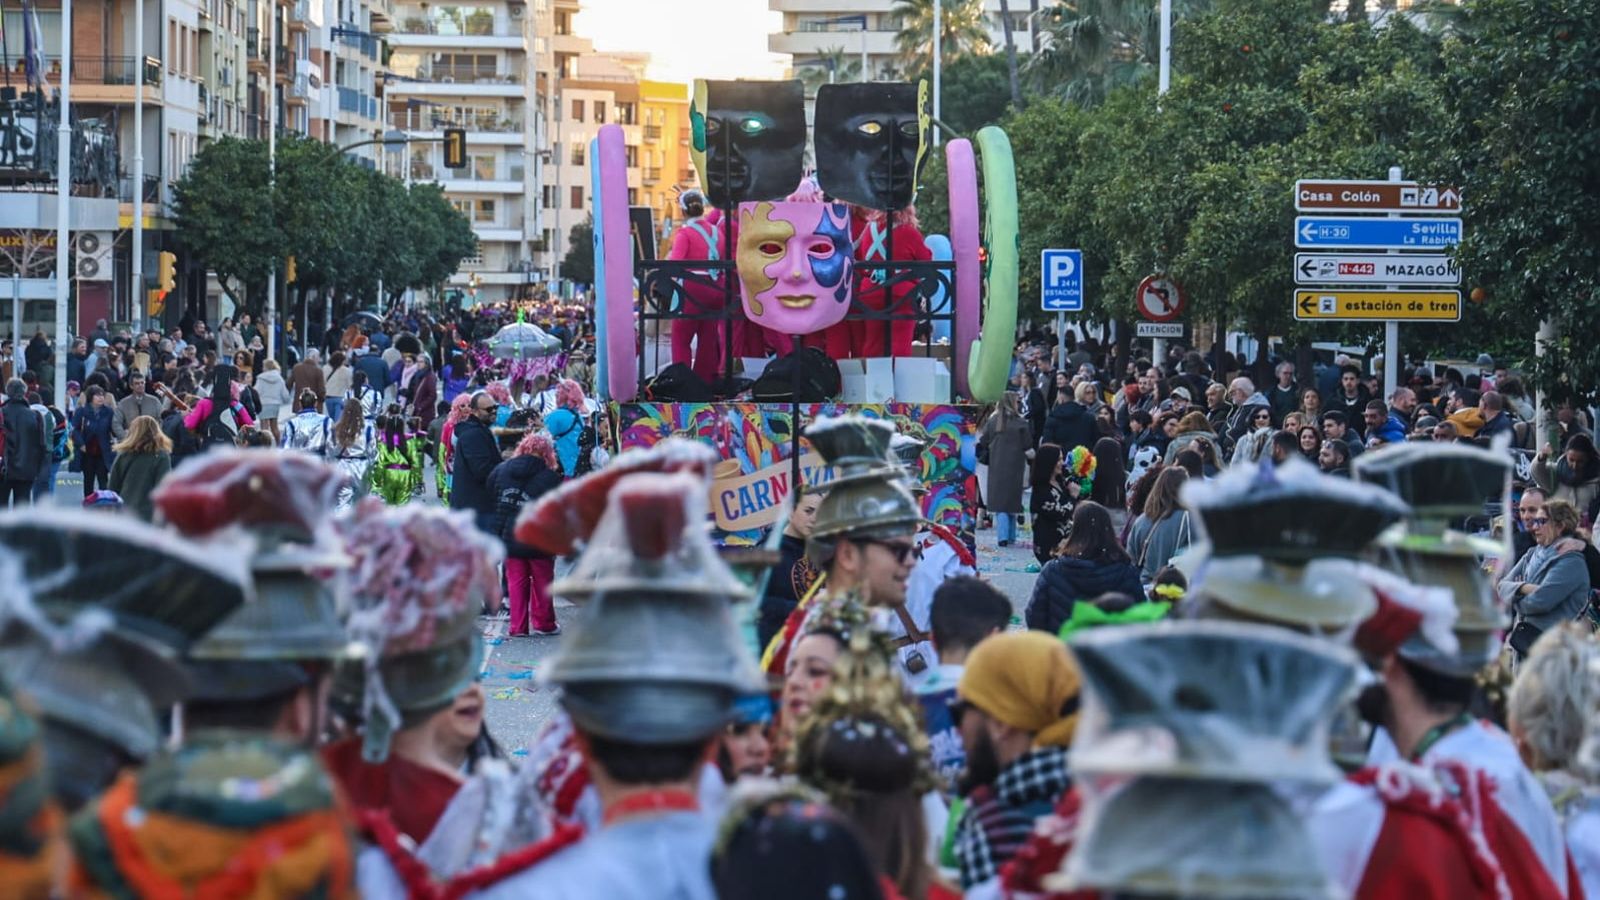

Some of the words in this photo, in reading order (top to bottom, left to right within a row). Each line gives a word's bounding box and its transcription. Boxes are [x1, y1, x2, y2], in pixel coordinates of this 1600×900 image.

[1300, 190, 1333, 202] Casa
[1341, 190, 1380, 202] Colón
[1321, 228, 1348, 237] H-30
[1412, 223, 1457, 234] Sevilla
[1403, 235, 1415, 244] La
[1050, 255, 1074, 287] P
[1339, 264, 1373, 274] N-442
[1386, 263, 1456, 276] MAZAGÓN
[1345, 300, 1402, 311] estación
[1407, 301, 1424, 311] de
[1430, 302, 1457, 311] tren
